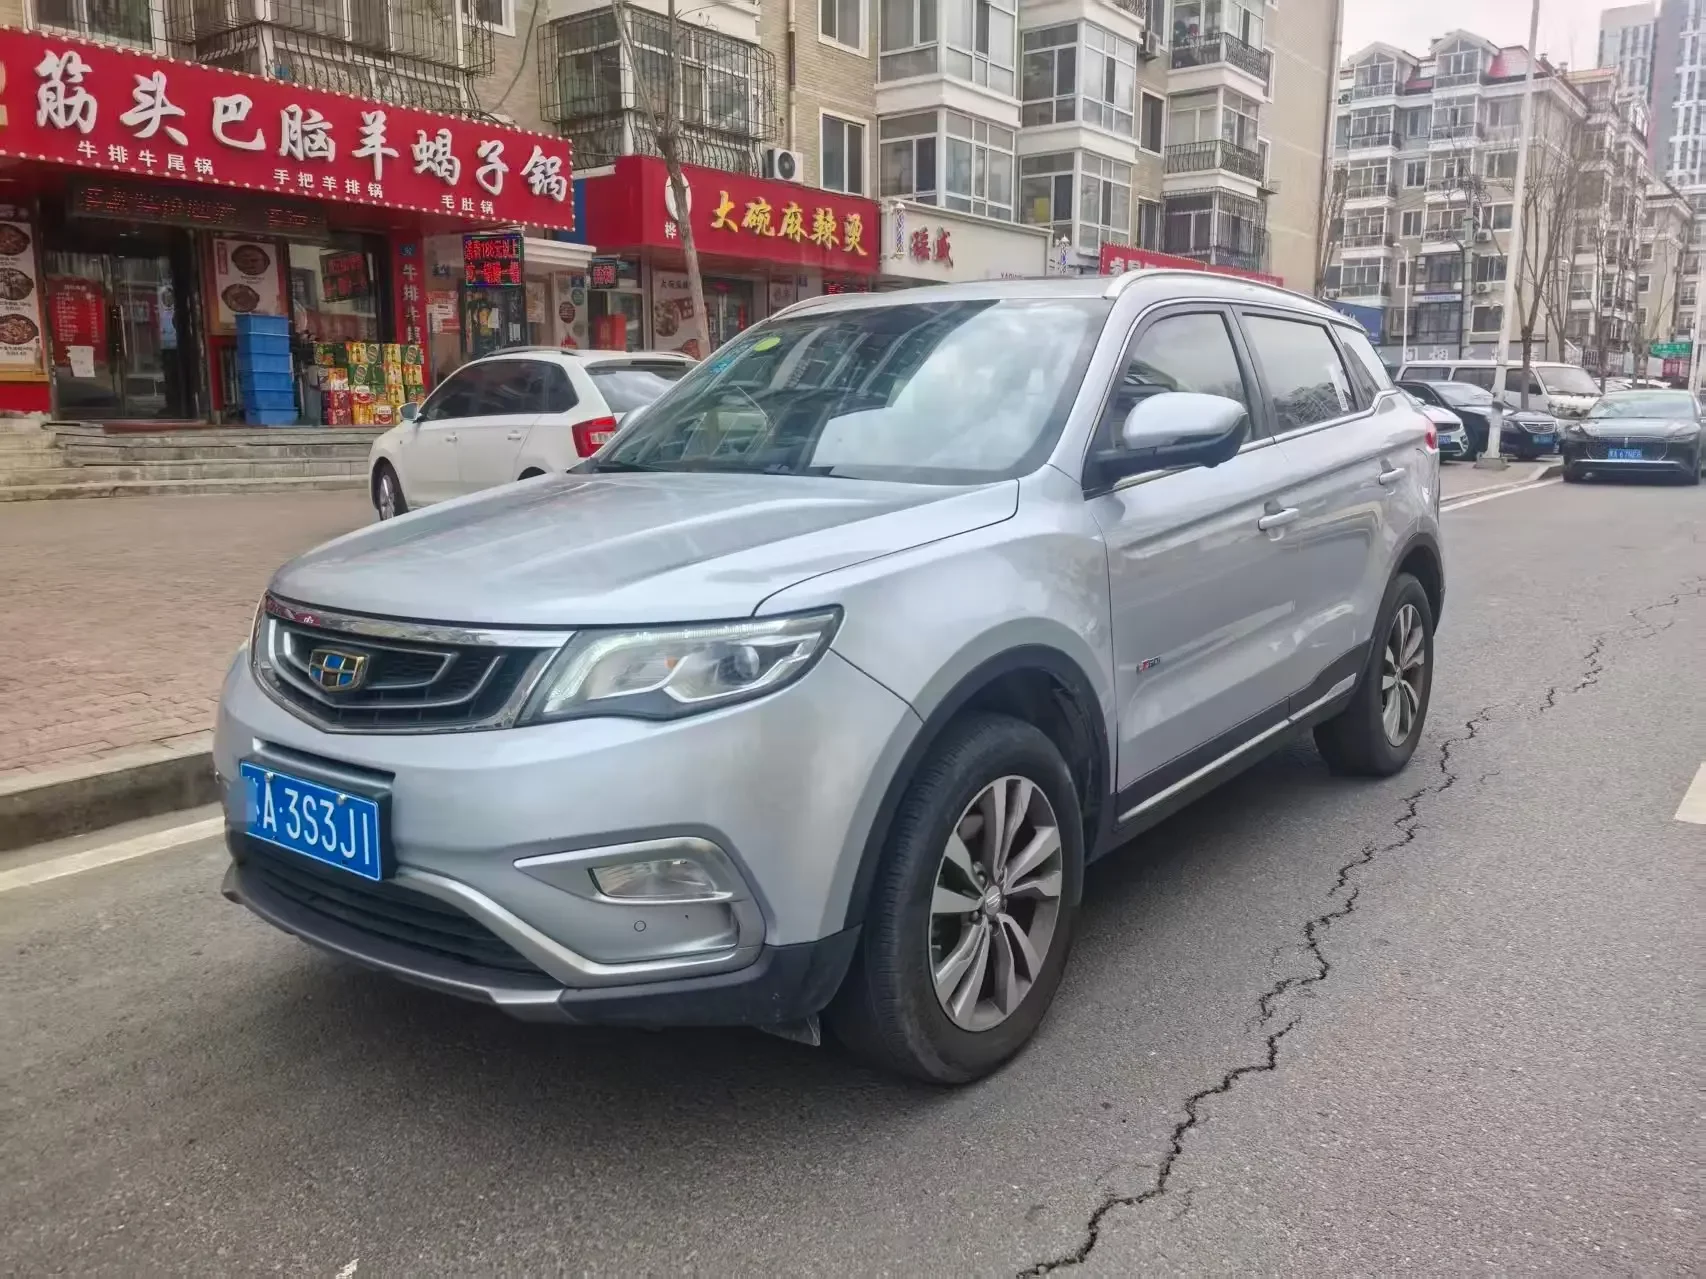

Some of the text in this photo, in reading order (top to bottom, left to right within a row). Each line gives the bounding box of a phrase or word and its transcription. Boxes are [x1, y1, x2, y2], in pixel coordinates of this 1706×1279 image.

[34, 48, 567, 202] 筋头巴脑羊蝎子锅
[77, 140, 214, 176] 牛排牛尾锅
[272, 168, 384, 199] 手把羊排锅
[440, 194, 494, 215] 毛肚锅
[709, 189, 868, 256] 大碗麻辣烫
[252, 777, 370, 866] A·3S3J1
